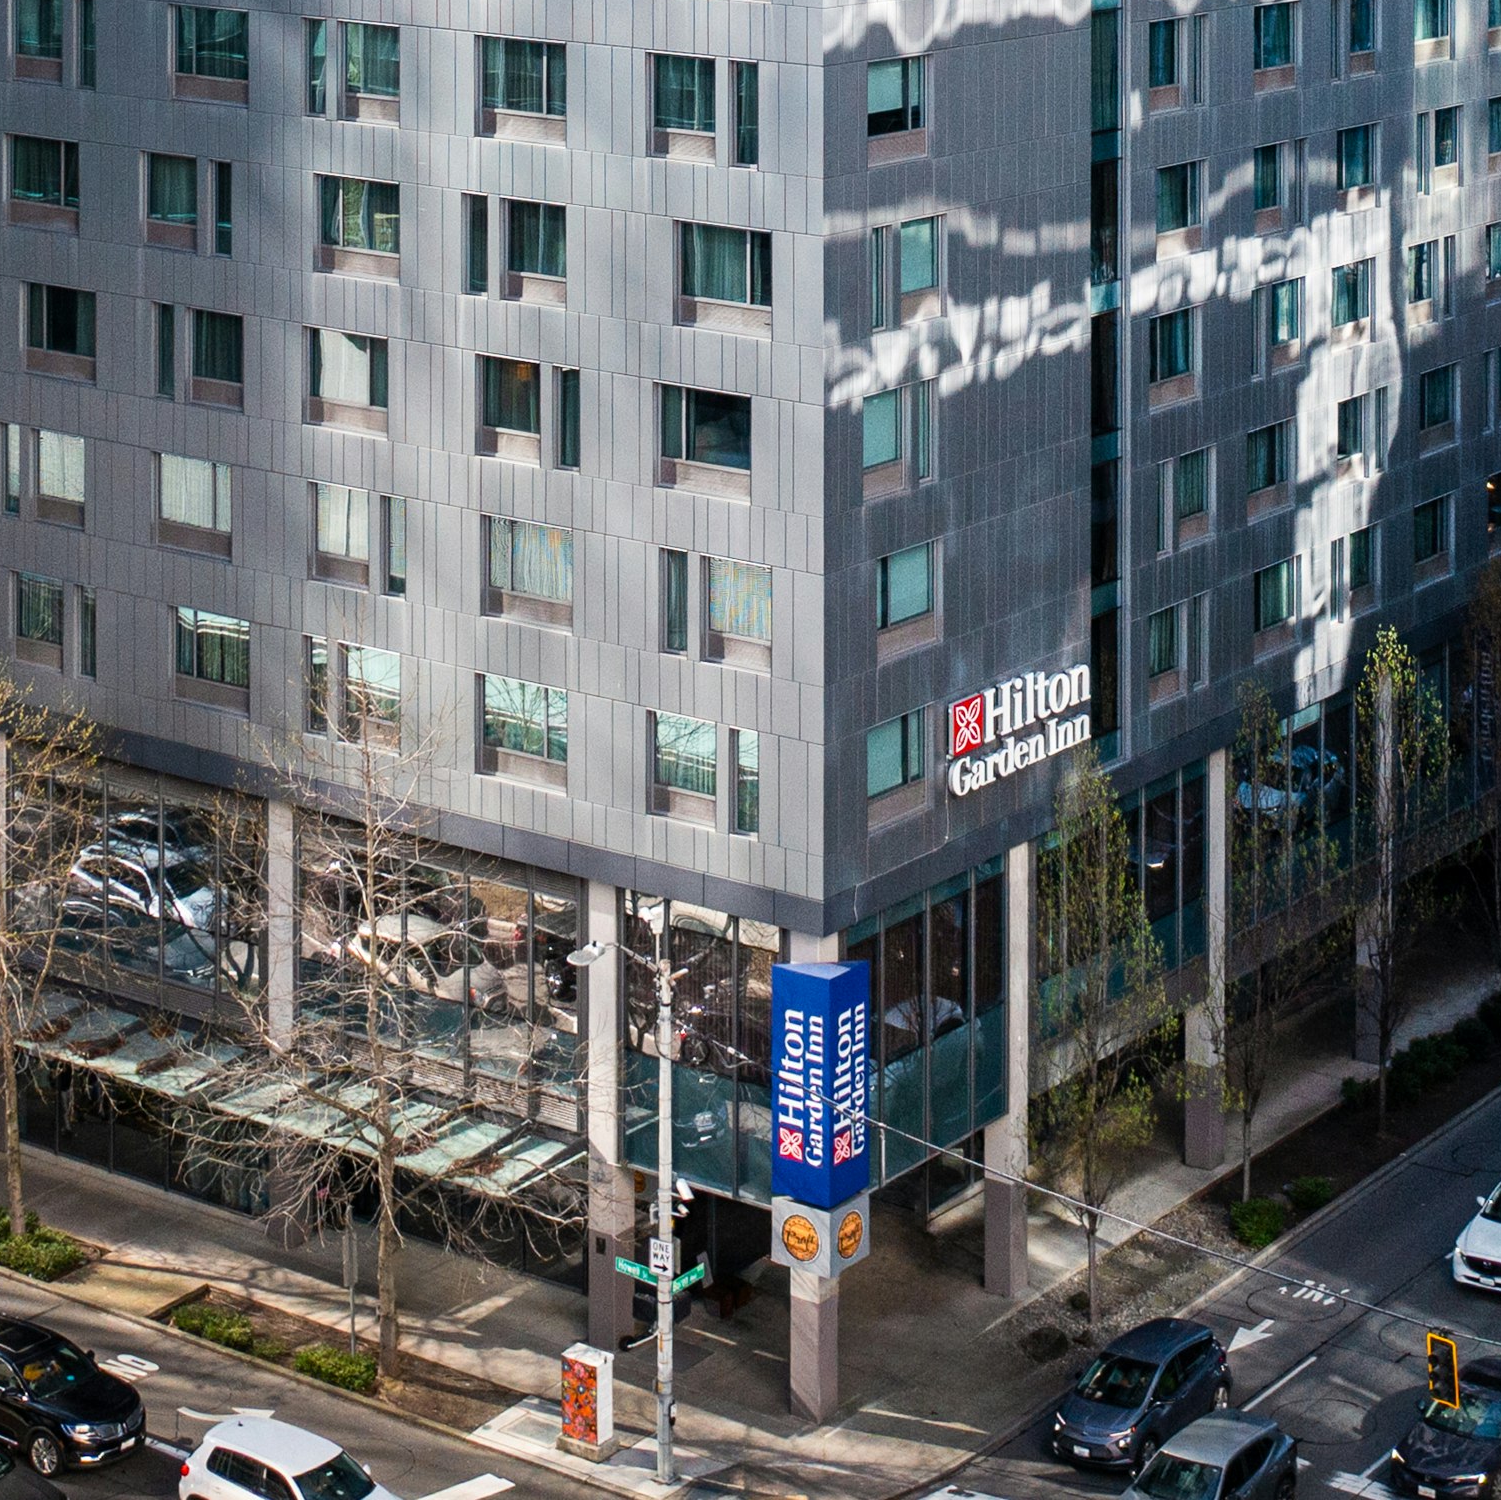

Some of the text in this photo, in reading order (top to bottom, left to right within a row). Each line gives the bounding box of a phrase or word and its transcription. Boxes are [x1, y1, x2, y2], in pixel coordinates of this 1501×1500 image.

[950, 713, 1091, 797] Garden Inn
[983, 664, 1091, 743] Hilton
[778, 1008, 804, 1130] Hilton
[804, 1014, 824, 1168] Garden Inn
[833, 1007, 852, 1135] Hilton
[852, 1001, 866, 1158] Garden Inn
[652, 1241, 670, 1254] ONE
[652, 1252, 670, 1263] WAY
